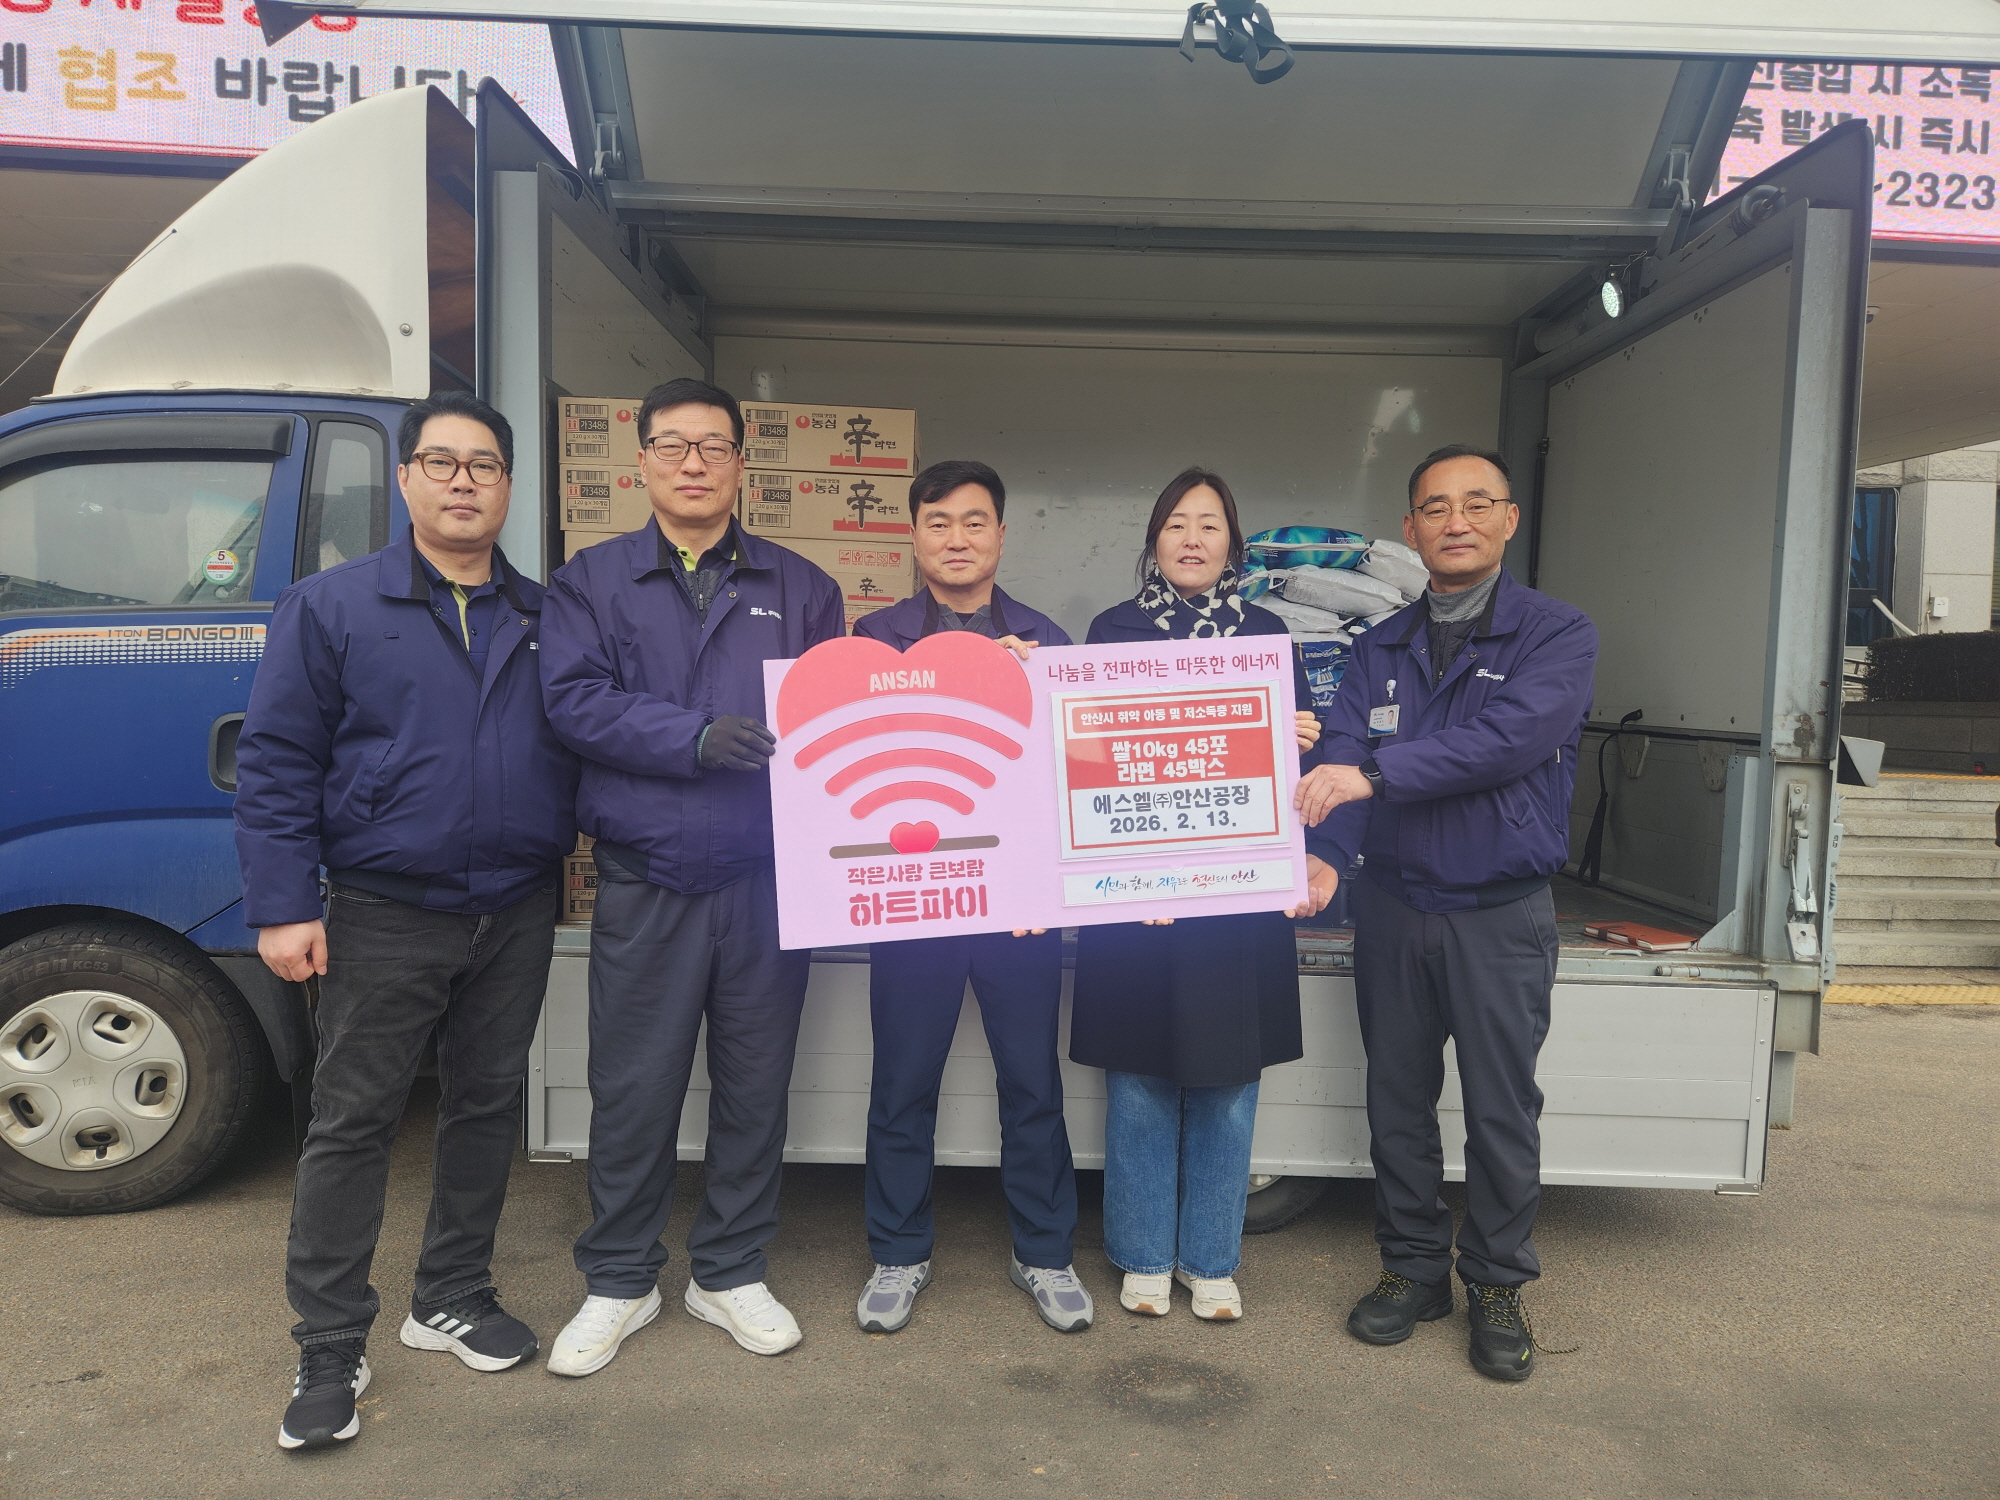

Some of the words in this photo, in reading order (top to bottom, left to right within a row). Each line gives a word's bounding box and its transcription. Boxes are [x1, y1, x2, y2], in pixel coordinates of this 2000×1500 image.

[57, 45, 187, 111] 협조
[1868, 66, 1903, 95] 시
[1919, 67, 1992, 102] 소독
[1919, 117, 1991, 155] 즉시
[812, 418, 837, 429] 농심
[844, 413, 880, 463] 辛
[874, 440, 897, 450] 라면
[815, 484, 840, 495] 농심
[847, 479, 883, 528] 辛
[877, 506, 900, 515] 라면
[217, 550, 226, 561] 5
[859, 577, 877, 599] 辛
[750, 607, 768, 616] SL
[114, 629, 143, 638] TON
[147, 627, 237, 642] BONGO
[1048, 664, 1096, 682] 나눔을
[1103, 659, 1169, 680] 전파하는
[1176, 656, 1225, 675] 따뜻한
[1232, 652, 1279, 671] 에너지
[1475, 668, 1491, 678] SL
[869, 670, 936, 693] ANSAN
[1081, 711, 1114, 726] 안산시
[1118, 710, 1140, 723] 취약
[1143, 708, 1165, 721] 아동
[1169, 707, 1181, 720] 및
[1231, 702, 1253, 716] 지원
[1112, 741, 1178, 762] 쌀10kg
[1184, 735, 1229, 756] 45포
[1117, 761, 1156, 783] 라면
[1163, 757, 1226, 778] 45박스
[1110, 814, 1168, 834] 2026.
[1177, 812, 1196, 830] 2.
[1207, 810, 1237, 828] 13.
[847, 863, 923, 885] 작은사랑
[929, 859, 985, 880] 큰보람
[1231, 869, 1260, 883] 안산
[849, 884, 988, 926] 하트파이
[72, 1076, 98, 1088] KIA
